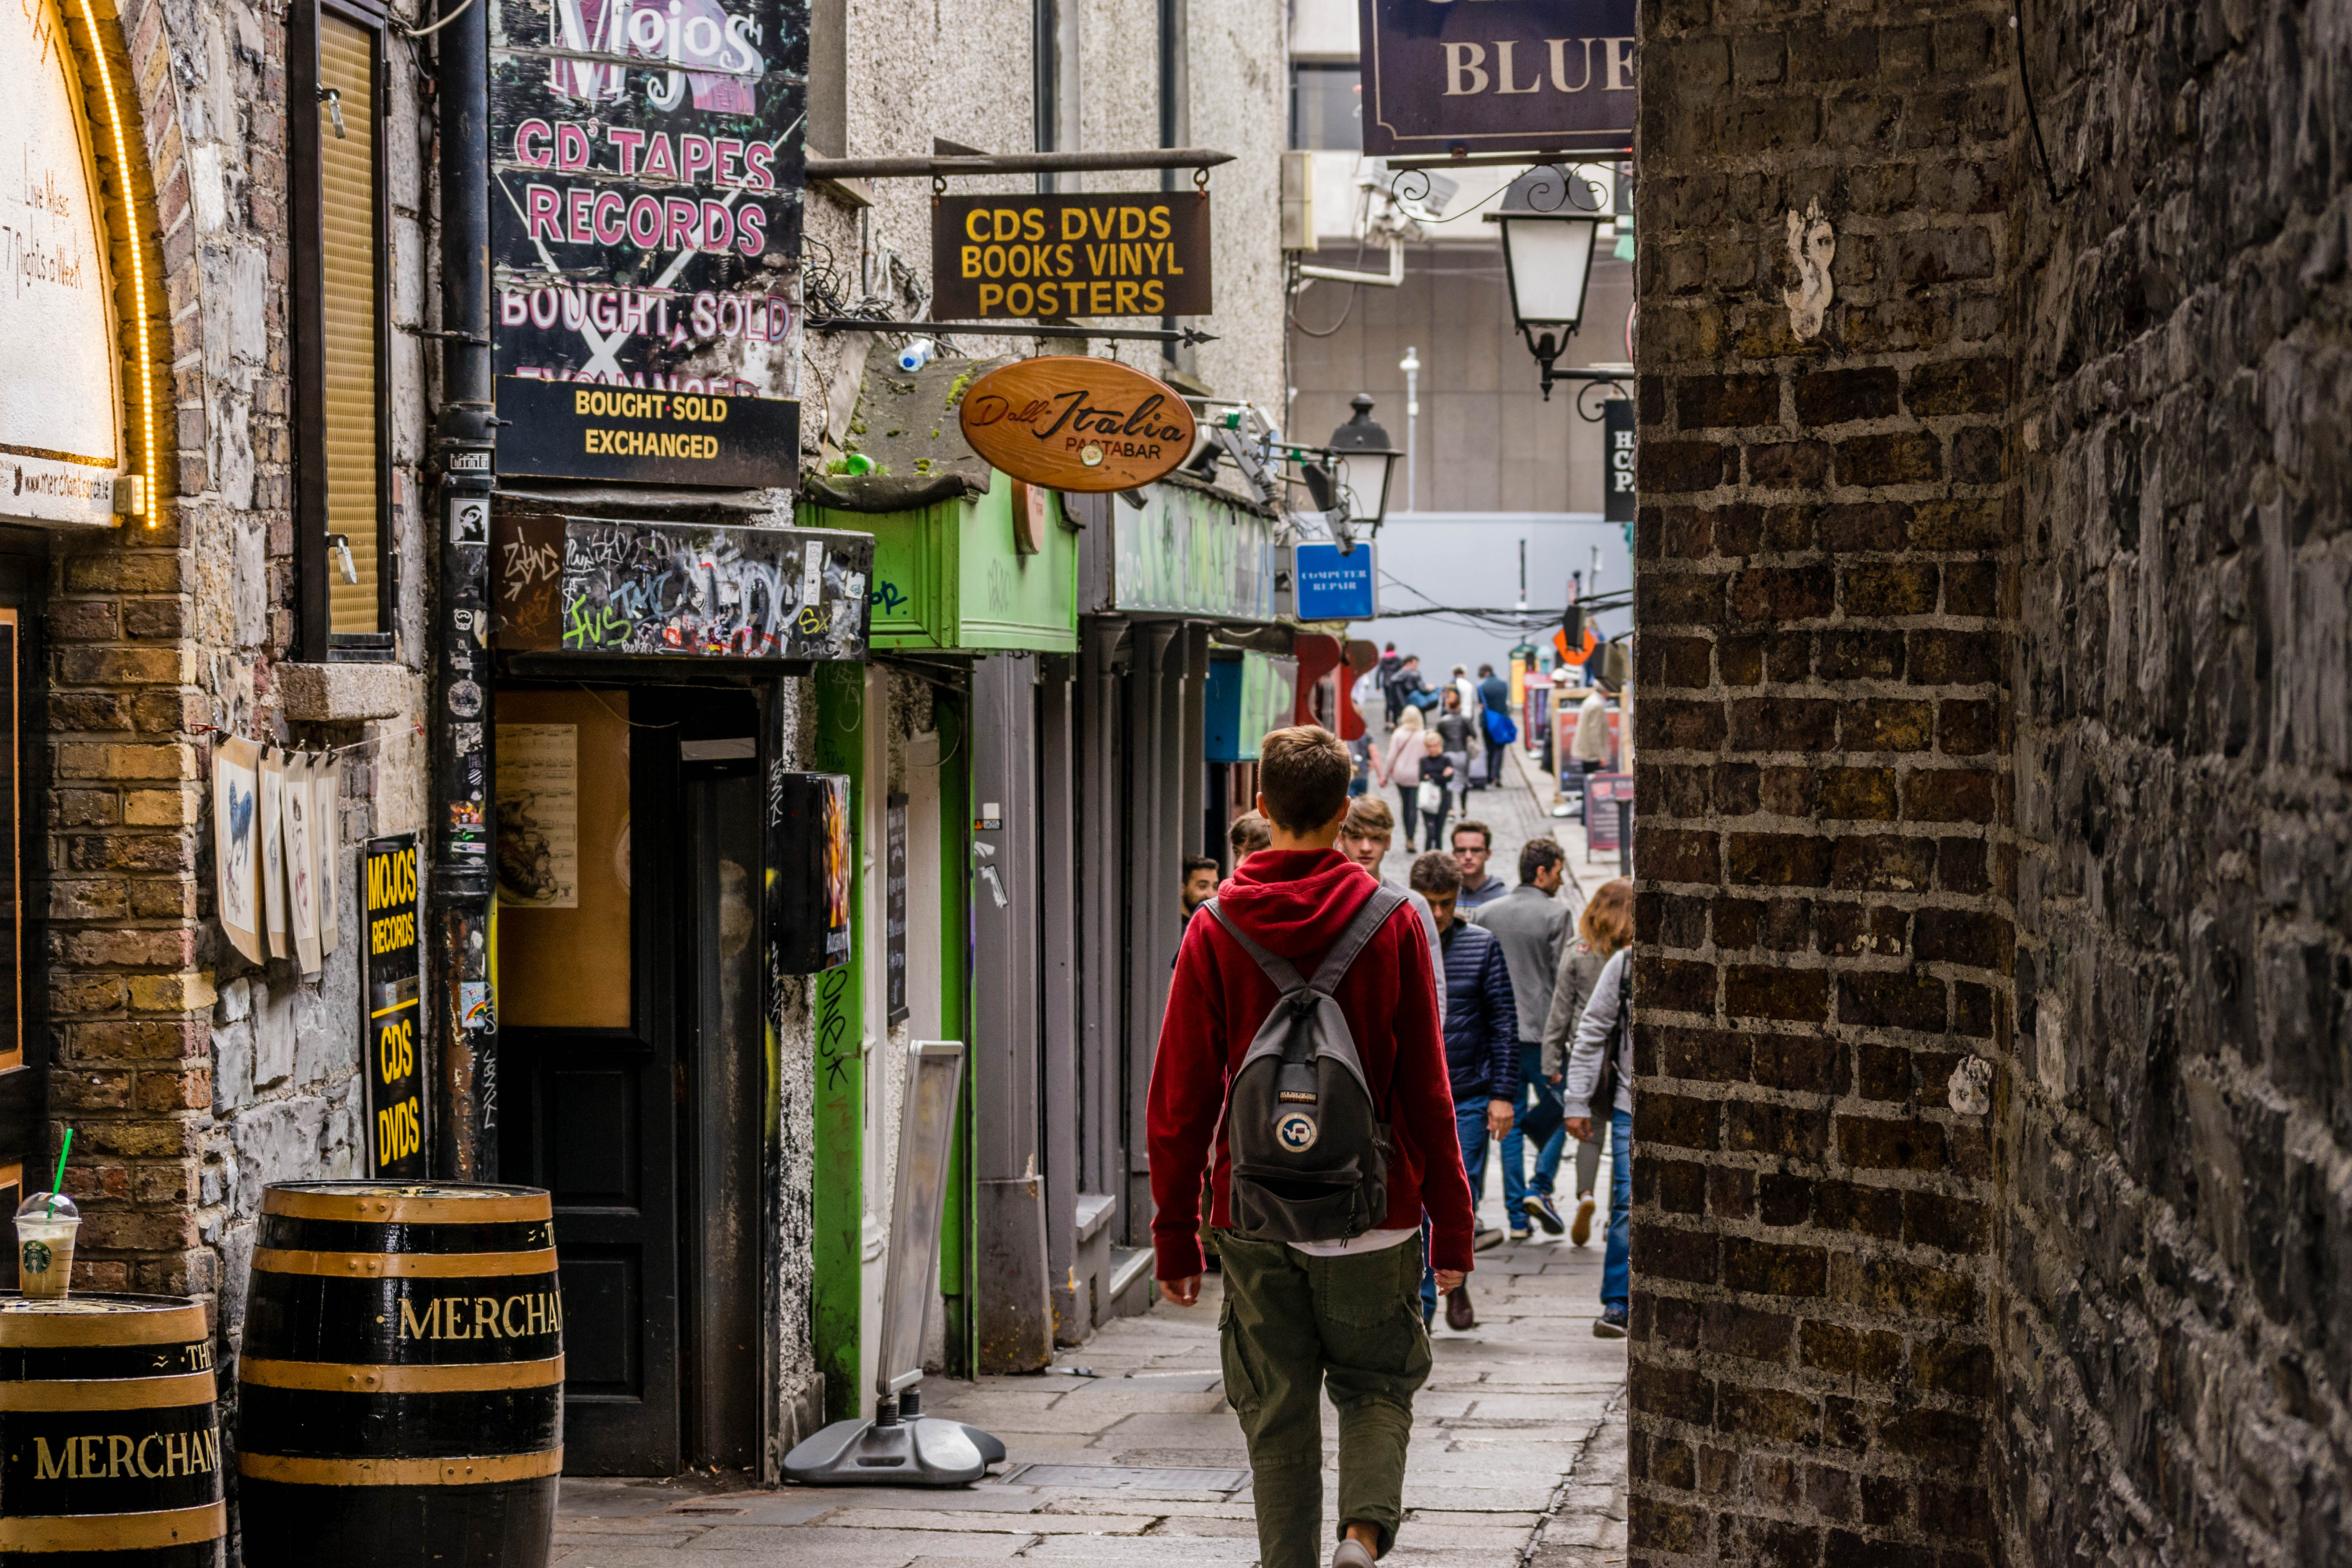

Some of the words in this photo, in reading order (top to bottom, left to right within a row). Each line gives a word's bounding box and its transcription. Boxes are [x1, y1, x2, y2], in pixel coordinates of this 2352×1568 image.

[543, 0, 762, 109] Mojos
[608, 127, 775, 195] TAPES
[527, 183, 766, 256] RECORDS
[966, 209, 1045, 241] CDS
[1061, 206, 1172, 240] DVDS
[962, 244, 1074, 278] BOOKS
[1086, 242, 1184, 276] VINYL
[693, 290, 789, 342] SOLD
[979, 280, 1165, 316] POSTERS
[672, 396, 728, 422] SOLD
[1032, 390, 1185, 441] Italia
[586, 428, 719, 459] EXCHANGED
[1302, 570, 1366, 580] COMPUTER
[1314, 582, 1356, 591] REPAIR
[368, 848, 416, 910] MOJOS
[372, 911, 414, 955] RECORDS
[381, 1019, 413, 1084] CDS
[379, 1095, 419, 1167] DVDS
